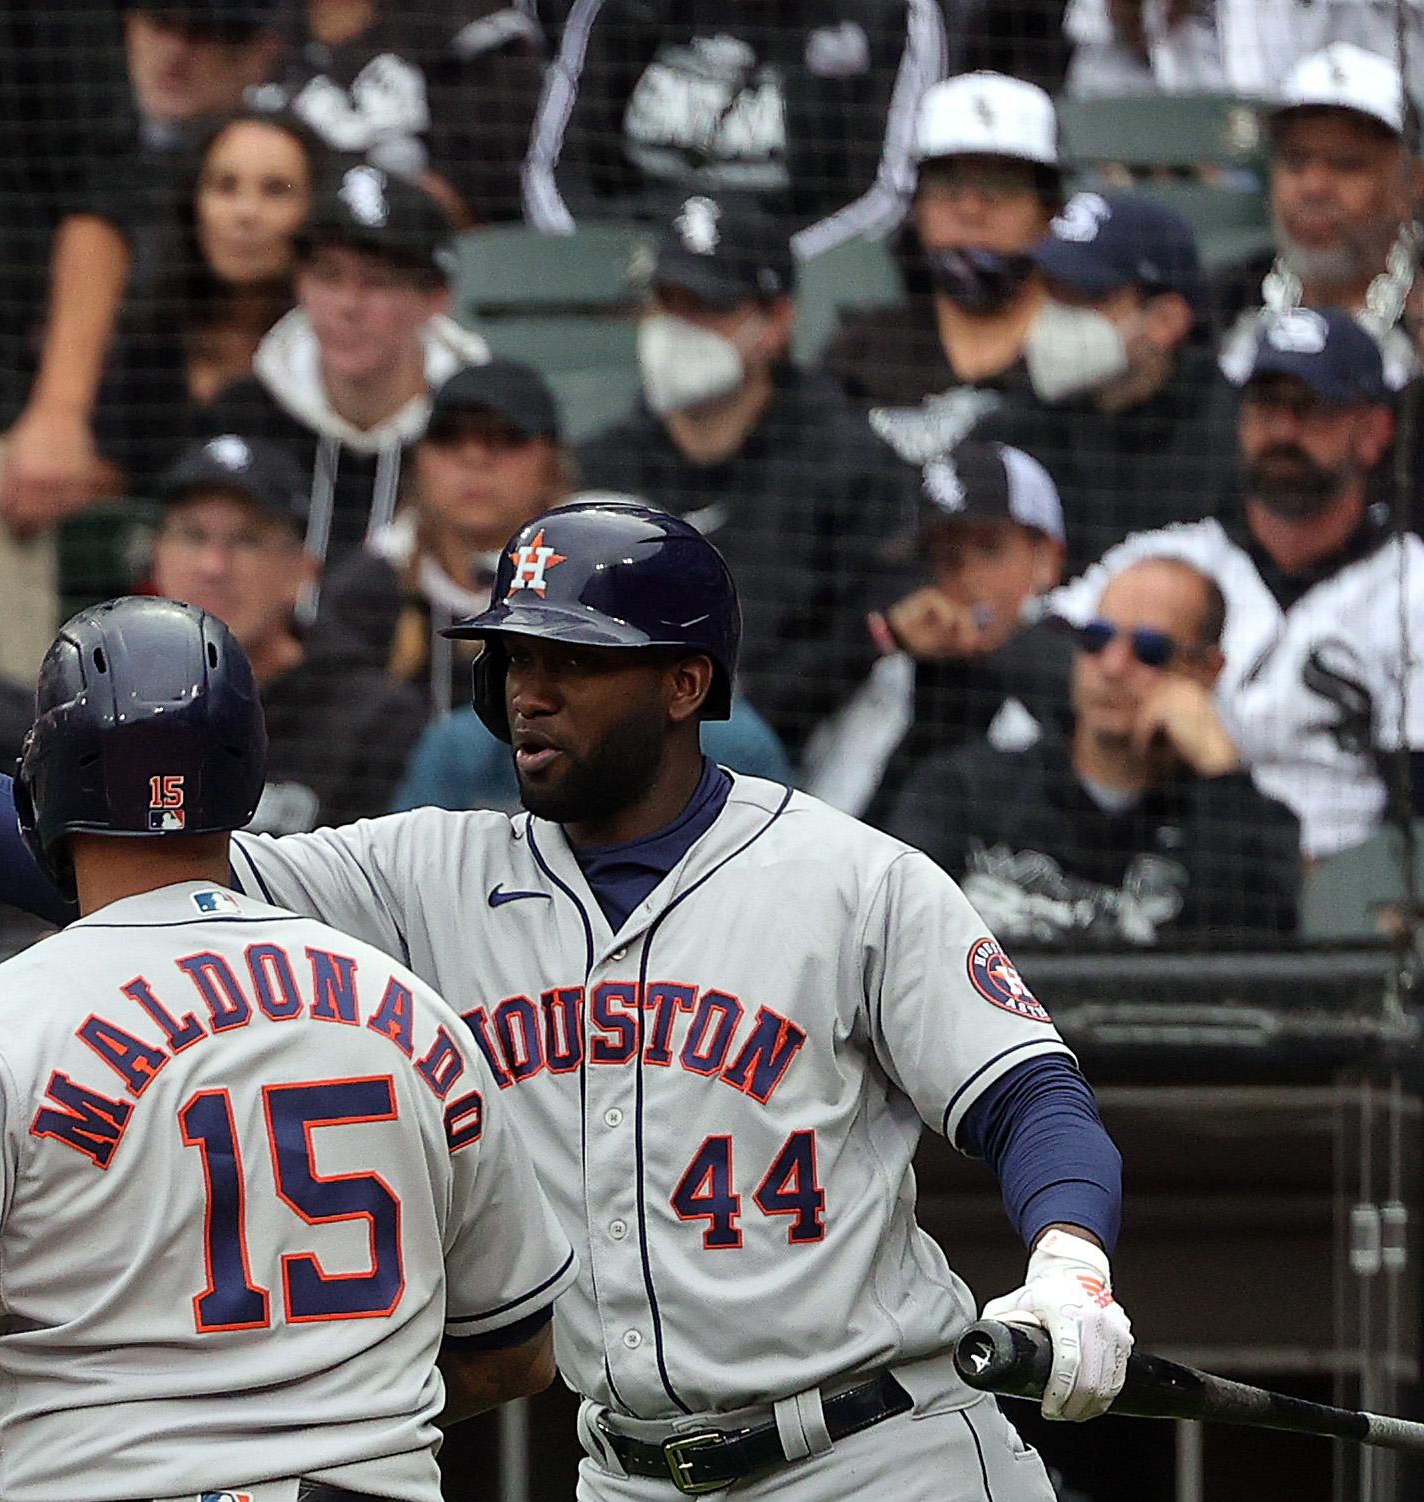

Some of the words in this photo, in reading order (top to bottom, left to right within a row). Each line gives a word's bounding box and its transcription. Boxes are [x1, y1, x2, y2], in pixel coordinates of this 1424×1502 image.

[149, 775, 184, 808] 15
[29, 942, 484, 1171] MALDONADO
[177, 1073, 407, 1334] 15
[669, 1128, 827, 1251] 44
